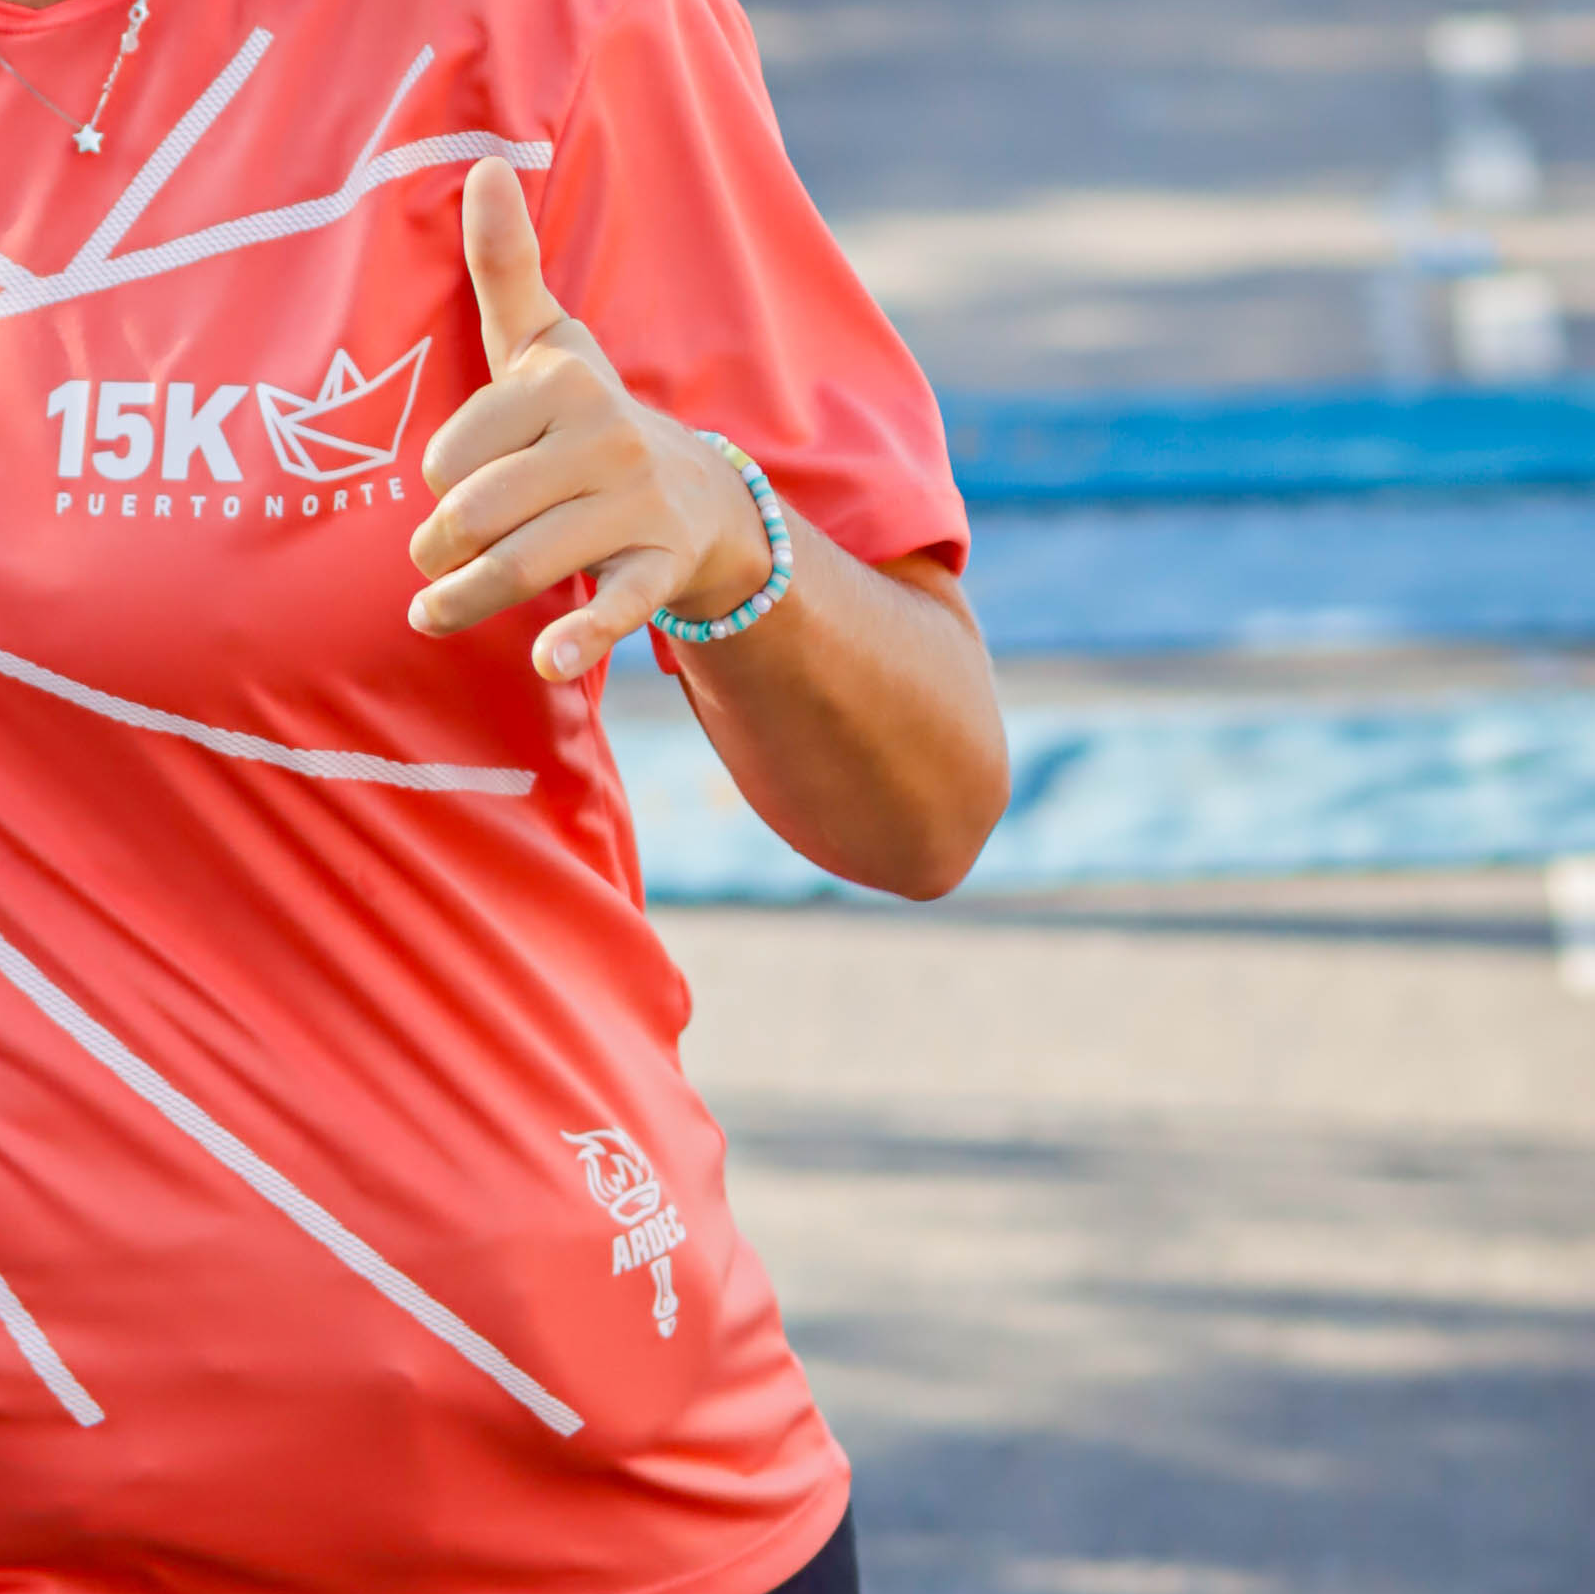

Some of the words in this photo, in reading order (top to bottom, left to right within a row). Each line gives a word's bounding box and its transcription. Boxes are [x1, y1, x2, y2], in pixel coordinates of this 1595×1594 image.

[46, 380, 249, 482] 15K
[57, 492, 240, 519] PUERTO
[265, 477, 405, 518] NORTE
